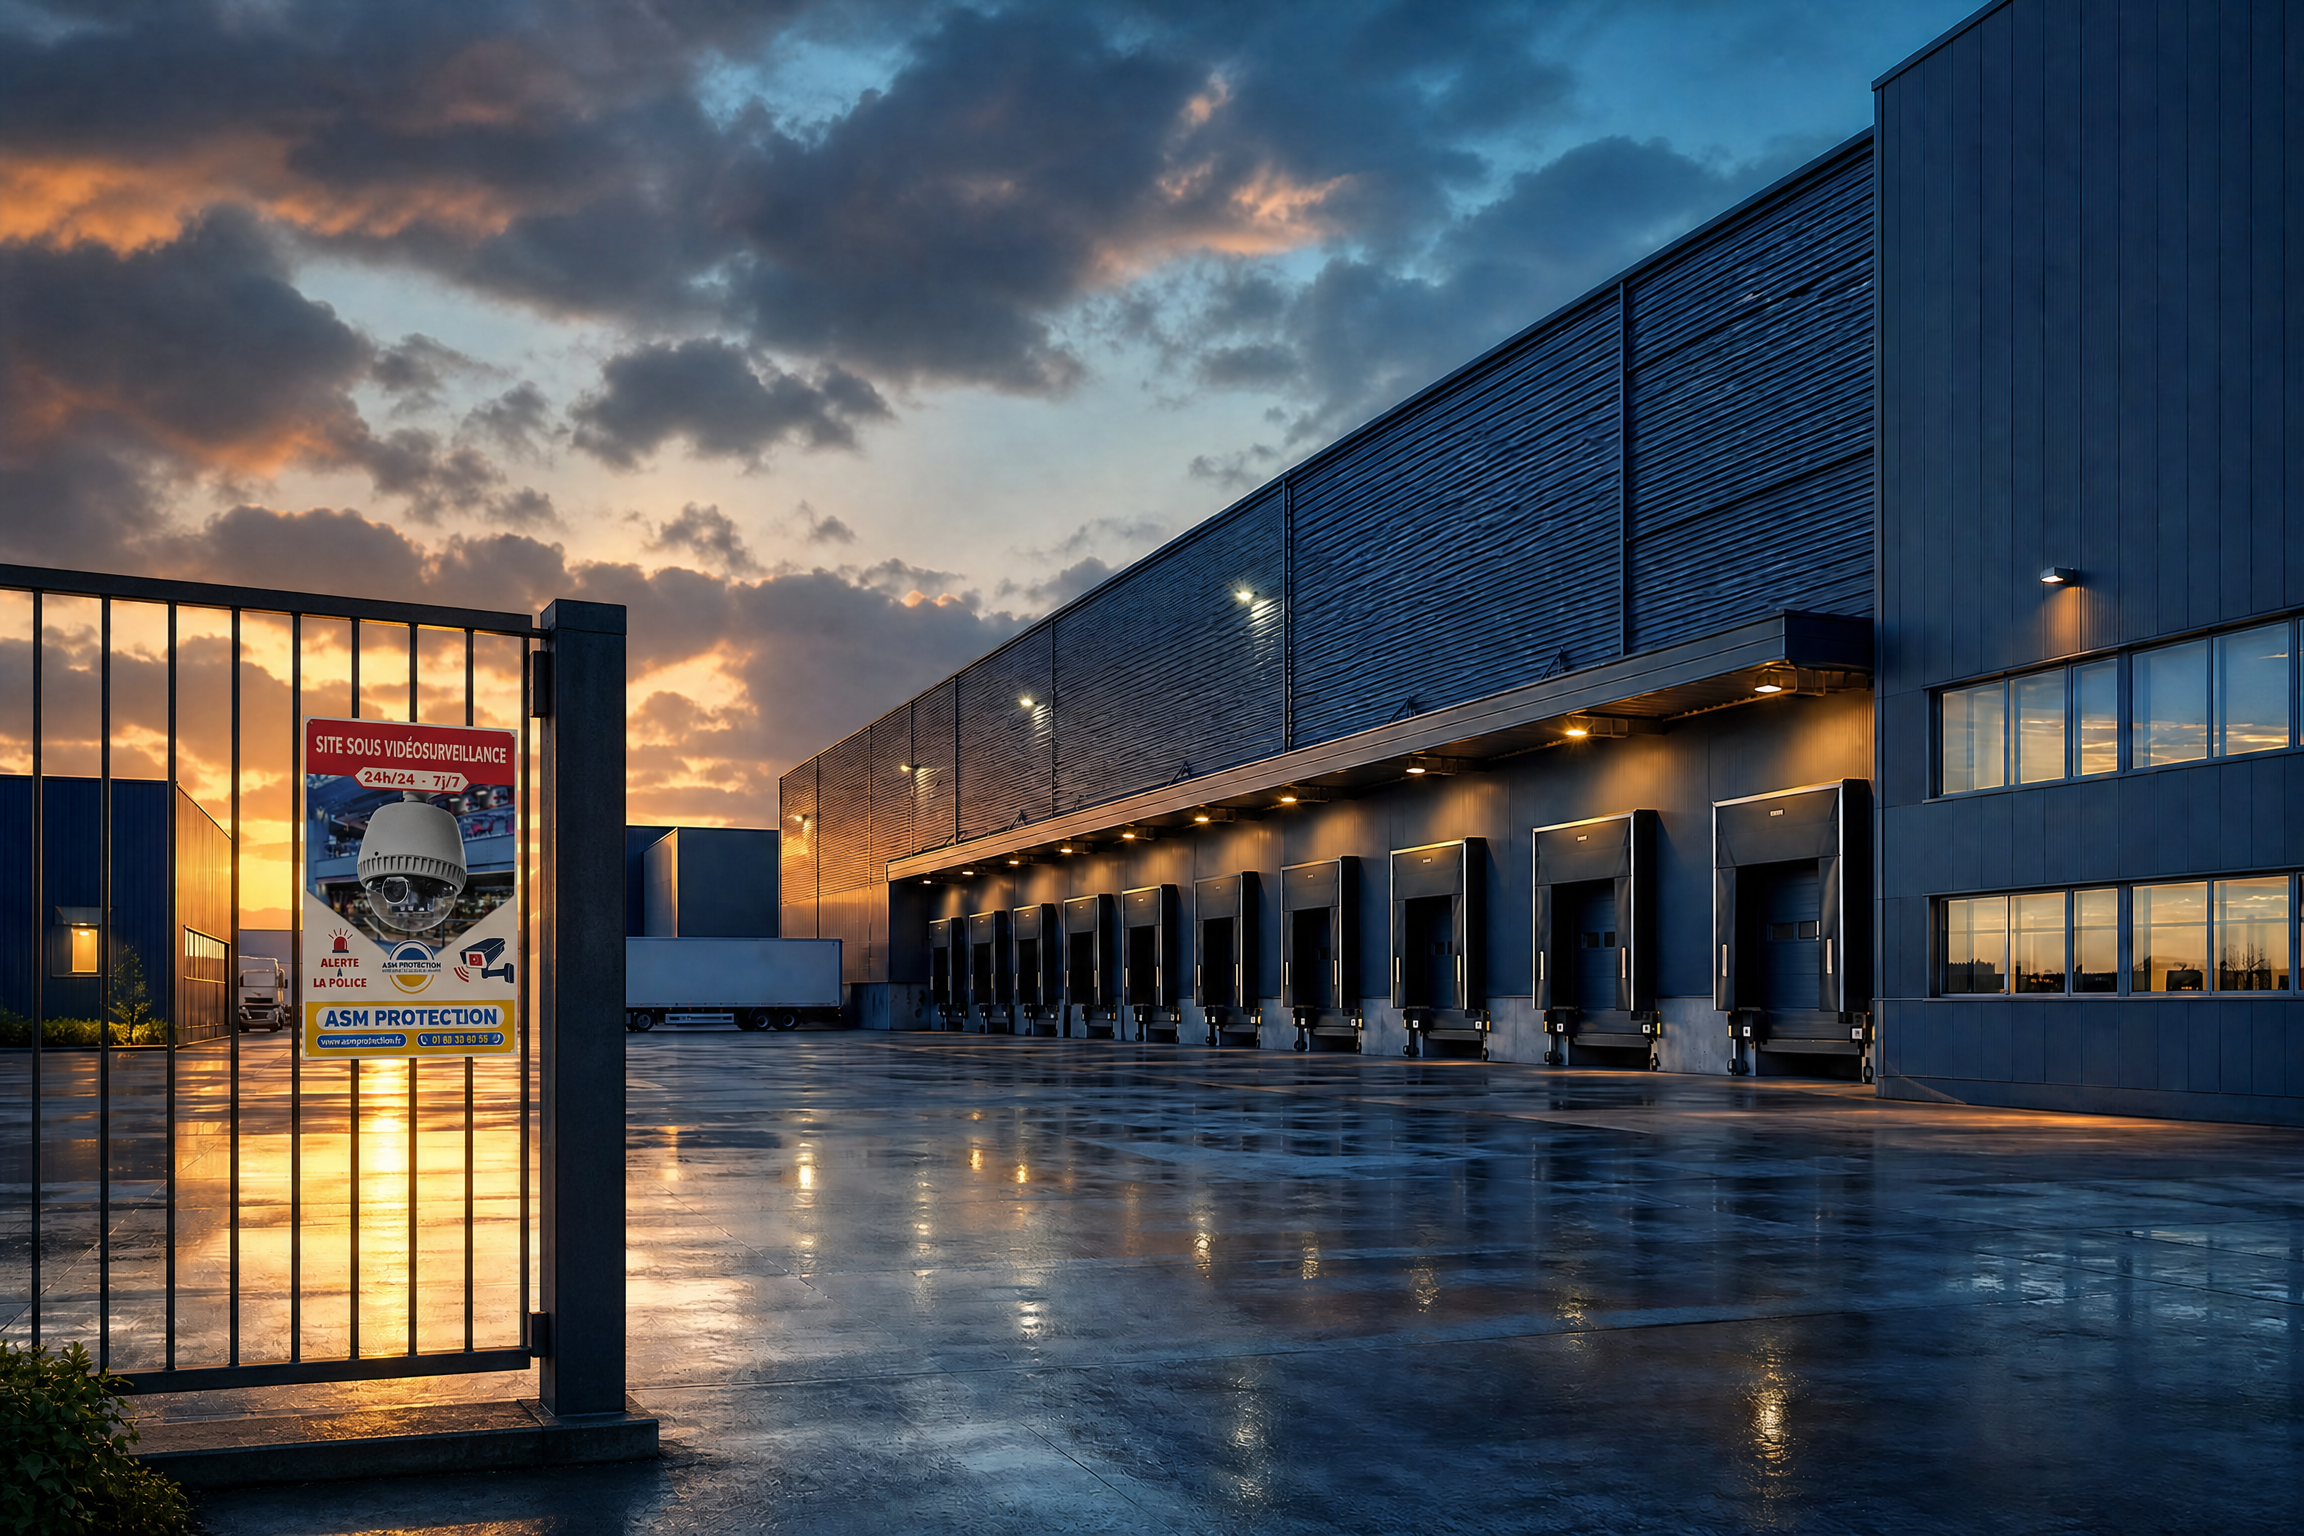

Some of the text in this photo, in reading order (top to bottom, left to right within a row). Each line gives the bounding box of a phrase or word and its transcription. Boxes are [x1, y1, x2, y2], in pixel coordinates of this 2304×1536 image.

[316, 735, 507, 764] SITE SOUS VIDÉOSURVEILLANCE
[364, 771, 415, 785] 24h/24
[433, 775, 460, 790] 7j/7
[320, 958, 359, 968] ALERTE
[313, 977, 367, 988] LA POLICE
[324, 1008, 497, 1027] ASM PROTECTION
[432, 1035, 441, 1044] 01
